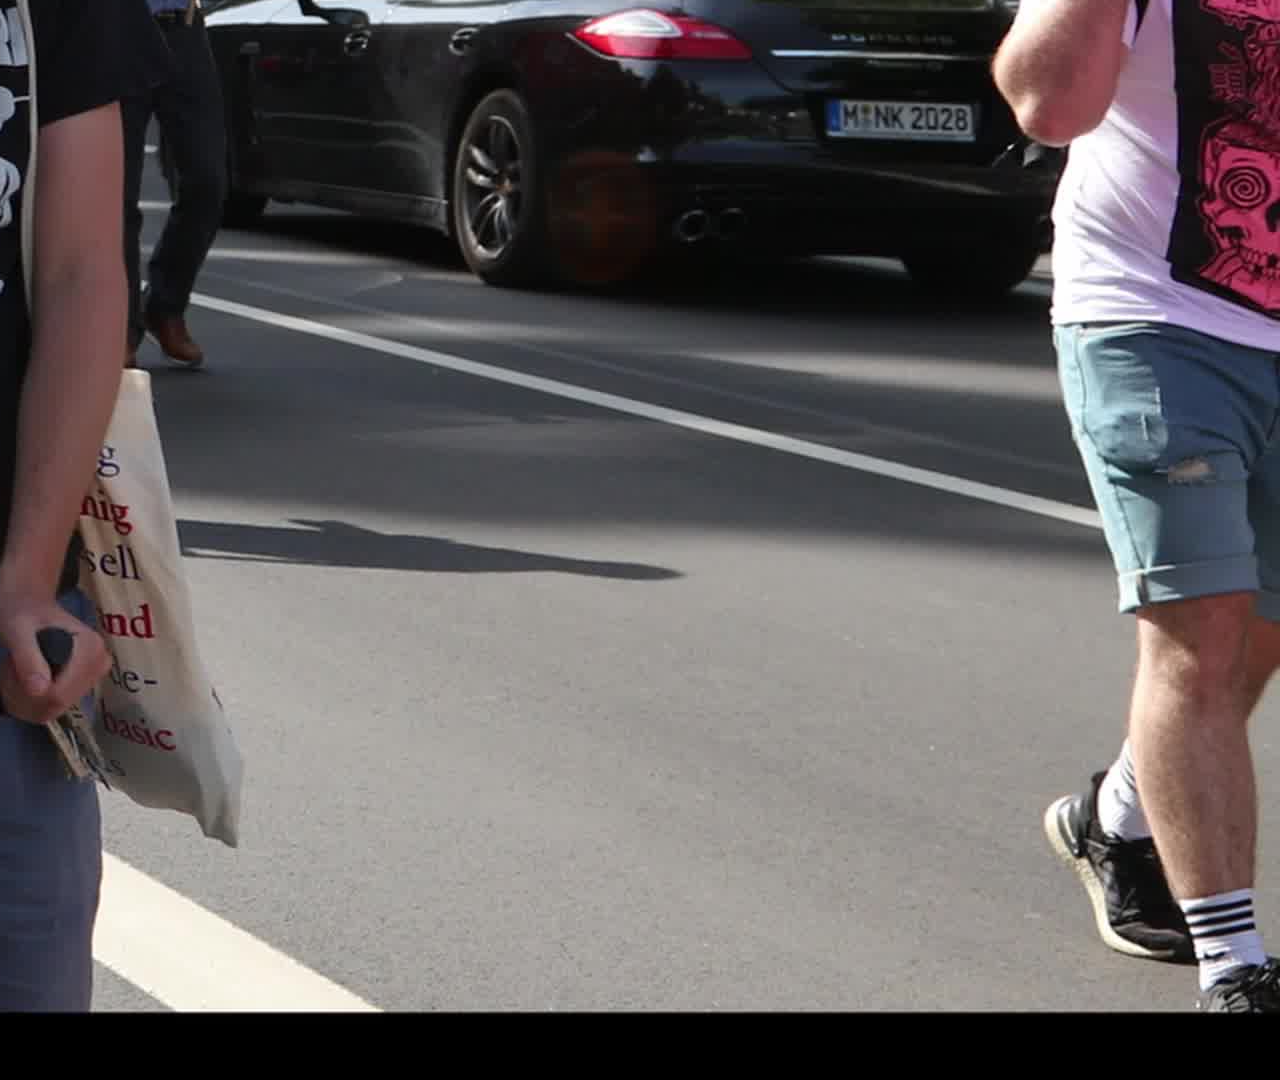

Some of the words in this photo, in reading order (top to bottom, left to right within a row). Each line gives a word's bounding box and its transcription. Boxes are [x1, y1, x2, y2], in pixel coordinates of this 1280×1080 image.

[844, 104, 859, 128] M
[874, 105, 905, 130] NK
[911, 107, 969, 132] 2028
[100, 697, 177, 752] basic
